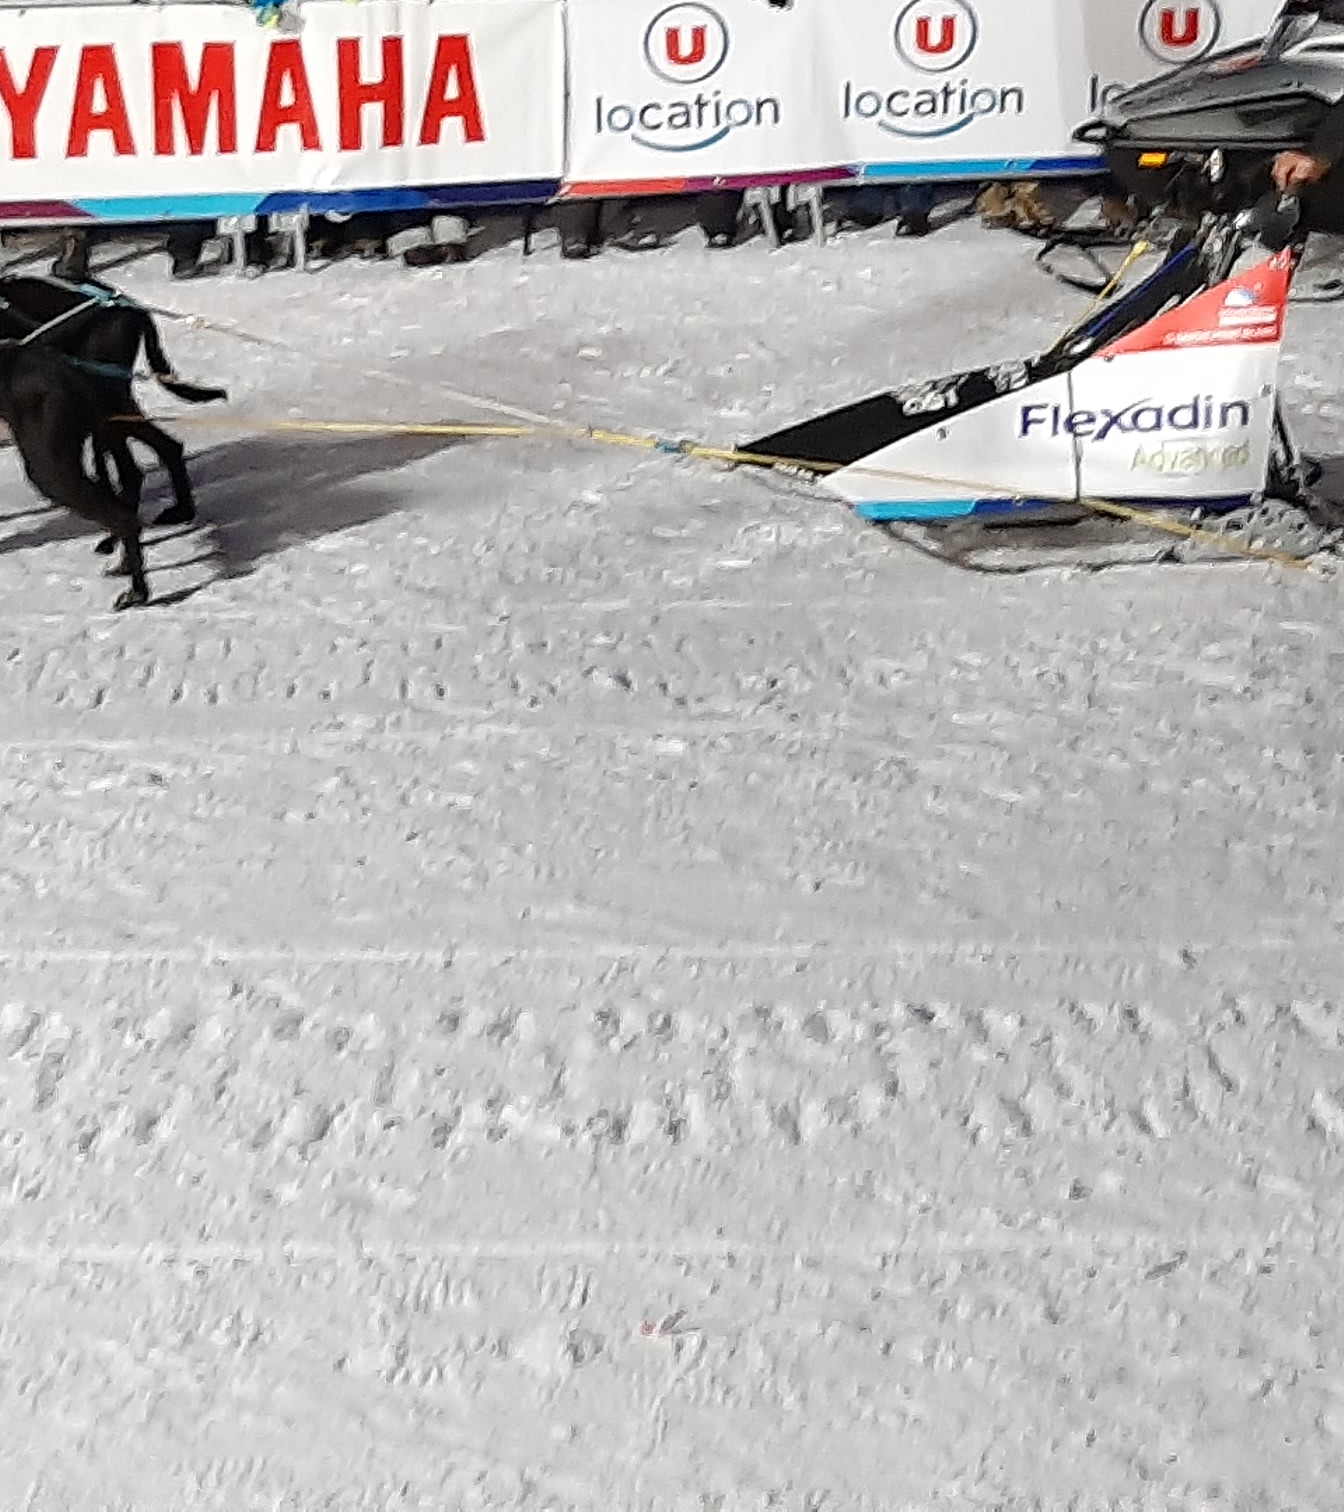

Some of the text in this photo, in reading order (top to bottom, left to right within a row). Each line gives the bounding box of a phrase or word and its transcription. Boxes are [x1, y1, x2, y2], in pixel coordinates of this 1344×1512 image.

[665, 24, 707, 66] U
[915, 14, 956, 54] U
[1161, 7, 1199, 46] U
[595, 90, 780, 134] location
[843, 79, 1024, 121] location
[1018, 394, 1250, 442] Flexadin
